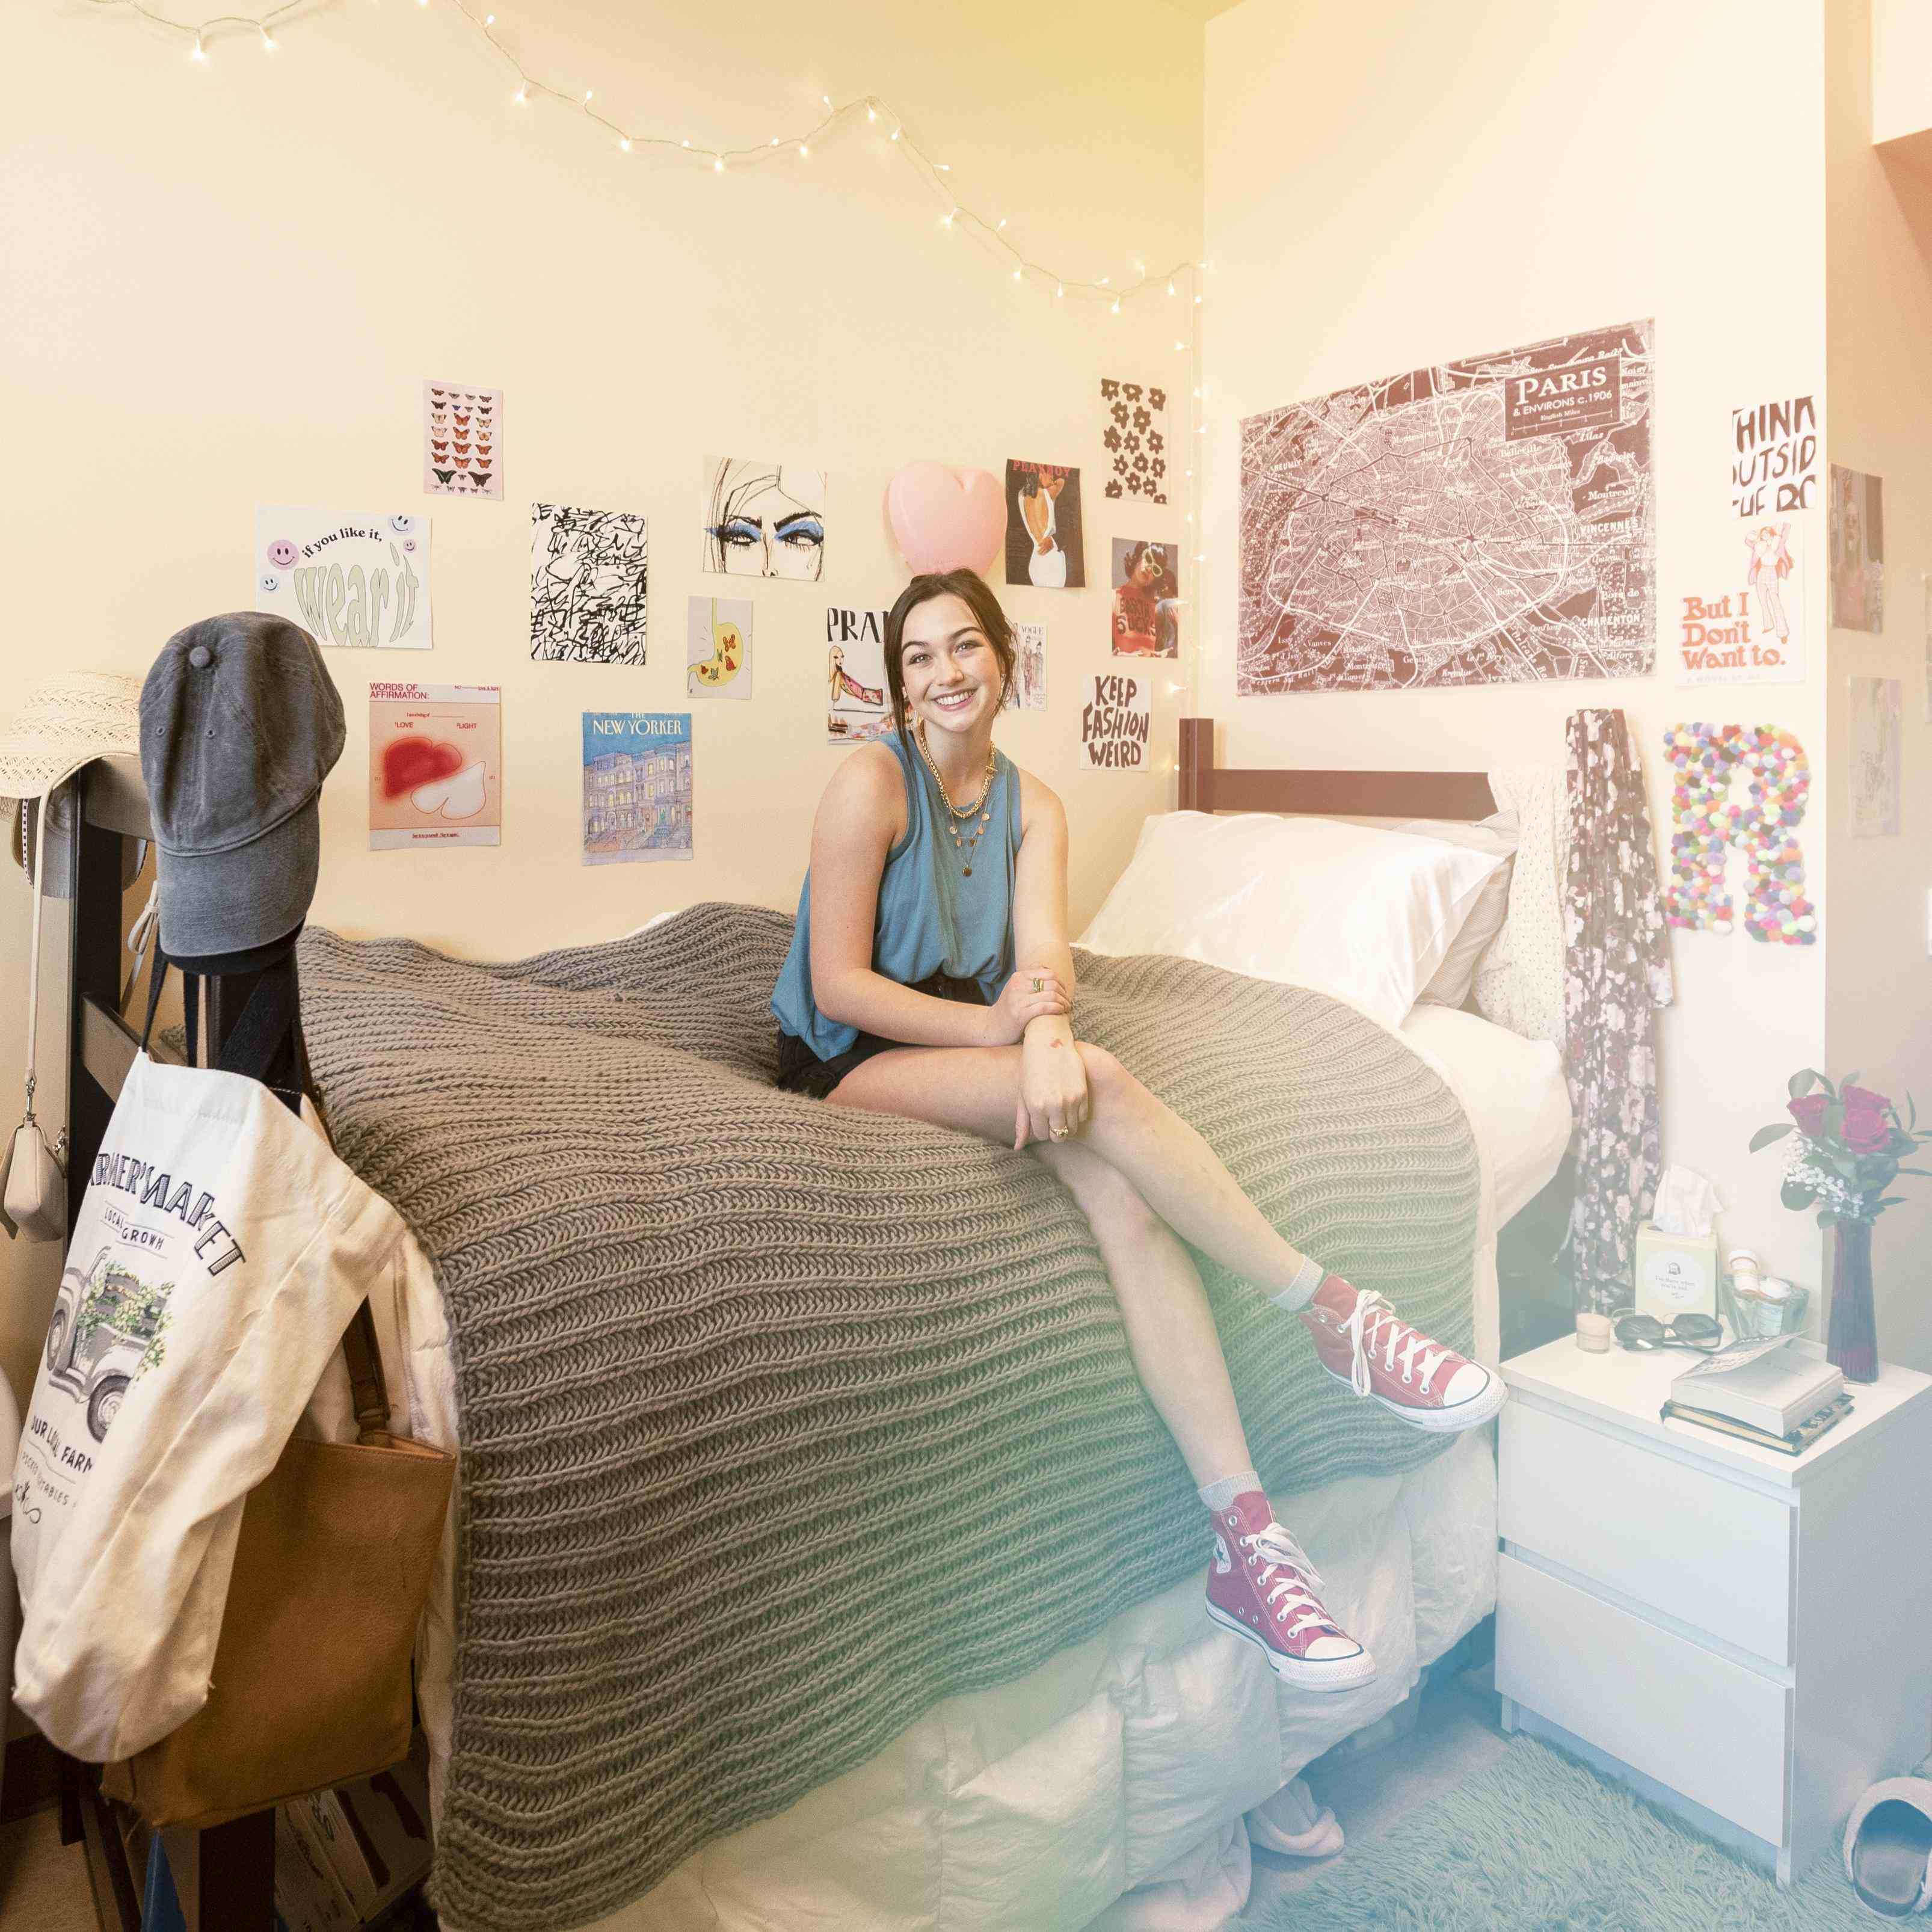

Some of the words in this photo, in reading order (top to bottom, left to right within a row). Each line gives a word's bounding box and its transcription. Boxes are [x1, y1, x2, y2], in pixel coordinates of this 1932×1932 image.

[1516, 366, 1607, 405] PARIS
[1513, 407, 1521, 417] &
[1524, 396, 1575, 415] ENVIRONS
[1578, 390, 1613, 405] c.1906
[302, 545, 315, 558] if
[313, 534, 337, 552] you
[339, 527, 366, 539] like
[369, 529, 383, 542] it,
[294, 563, 389, 647] wear
[1683, 595, 1732, 621] But
[1740, 592, 1749, 617] I
[1021, 625, 1044, 635] VOGUE
[1682, 620, 1752, 647] Don't
[1682, 646, 1747, 670] Want
[1752, 645, 1786, 666] to.
[370, 683, 404, 692] WORDS
[370, 691, 430, 700] AFFIRMATION:
[1095, 675, 1137, 707] KEEP
[593, 720, 626, 736] NEW
[628, 719, 683, 736] YORKER
[1082, 701, 1149, 743] FASHION
[1088, 740, 1141, 768] WEIRD
[104, 1207, 125, 1228] LOCAL
[122, 1228, 164, 1251] GROWN
